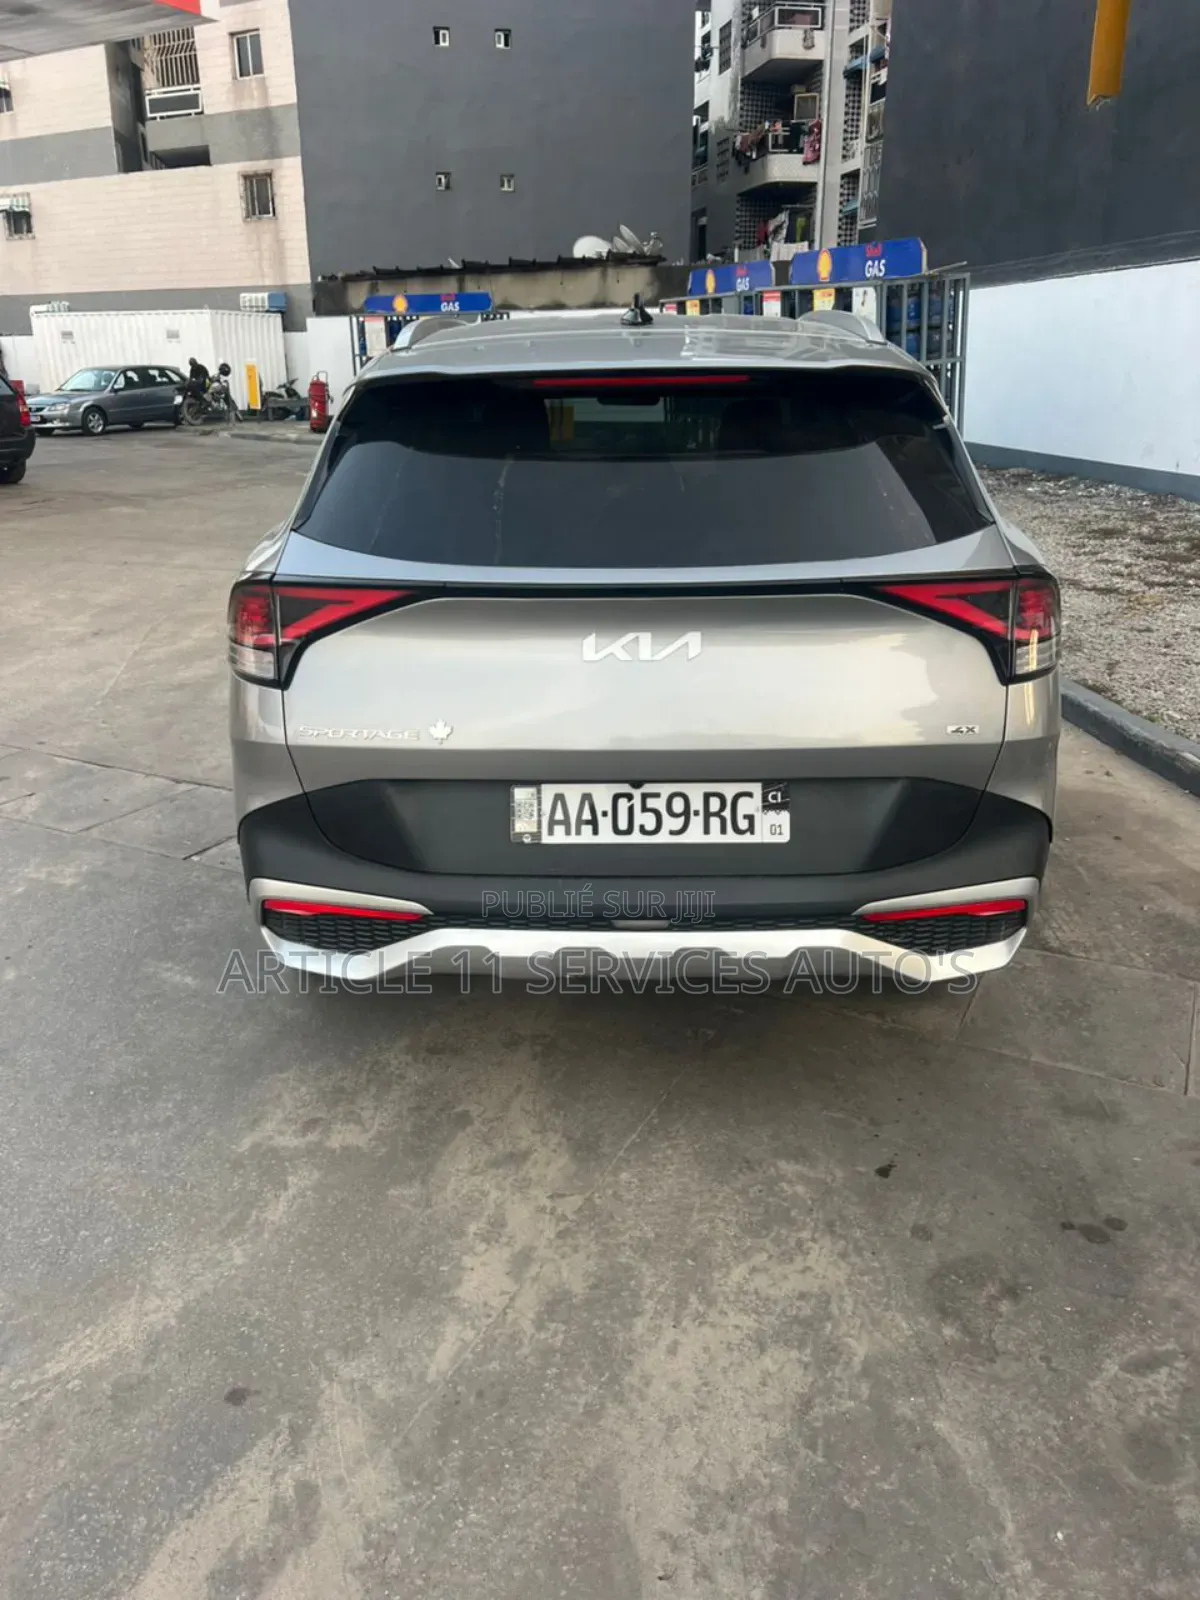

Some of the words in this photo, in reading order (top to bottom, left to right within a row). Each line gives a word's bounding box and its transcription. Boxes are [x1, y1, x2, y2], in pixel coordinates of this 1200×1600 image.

[865, 259, 886, 278] GAS
[736, 276, 750, 292] GAS
[440, 302, 460, 312] GAS
[582, 631, 702, 661] KIA
[299, 723, 421, 741] SPORTAGE
[769, 823, 784, 836] 01
